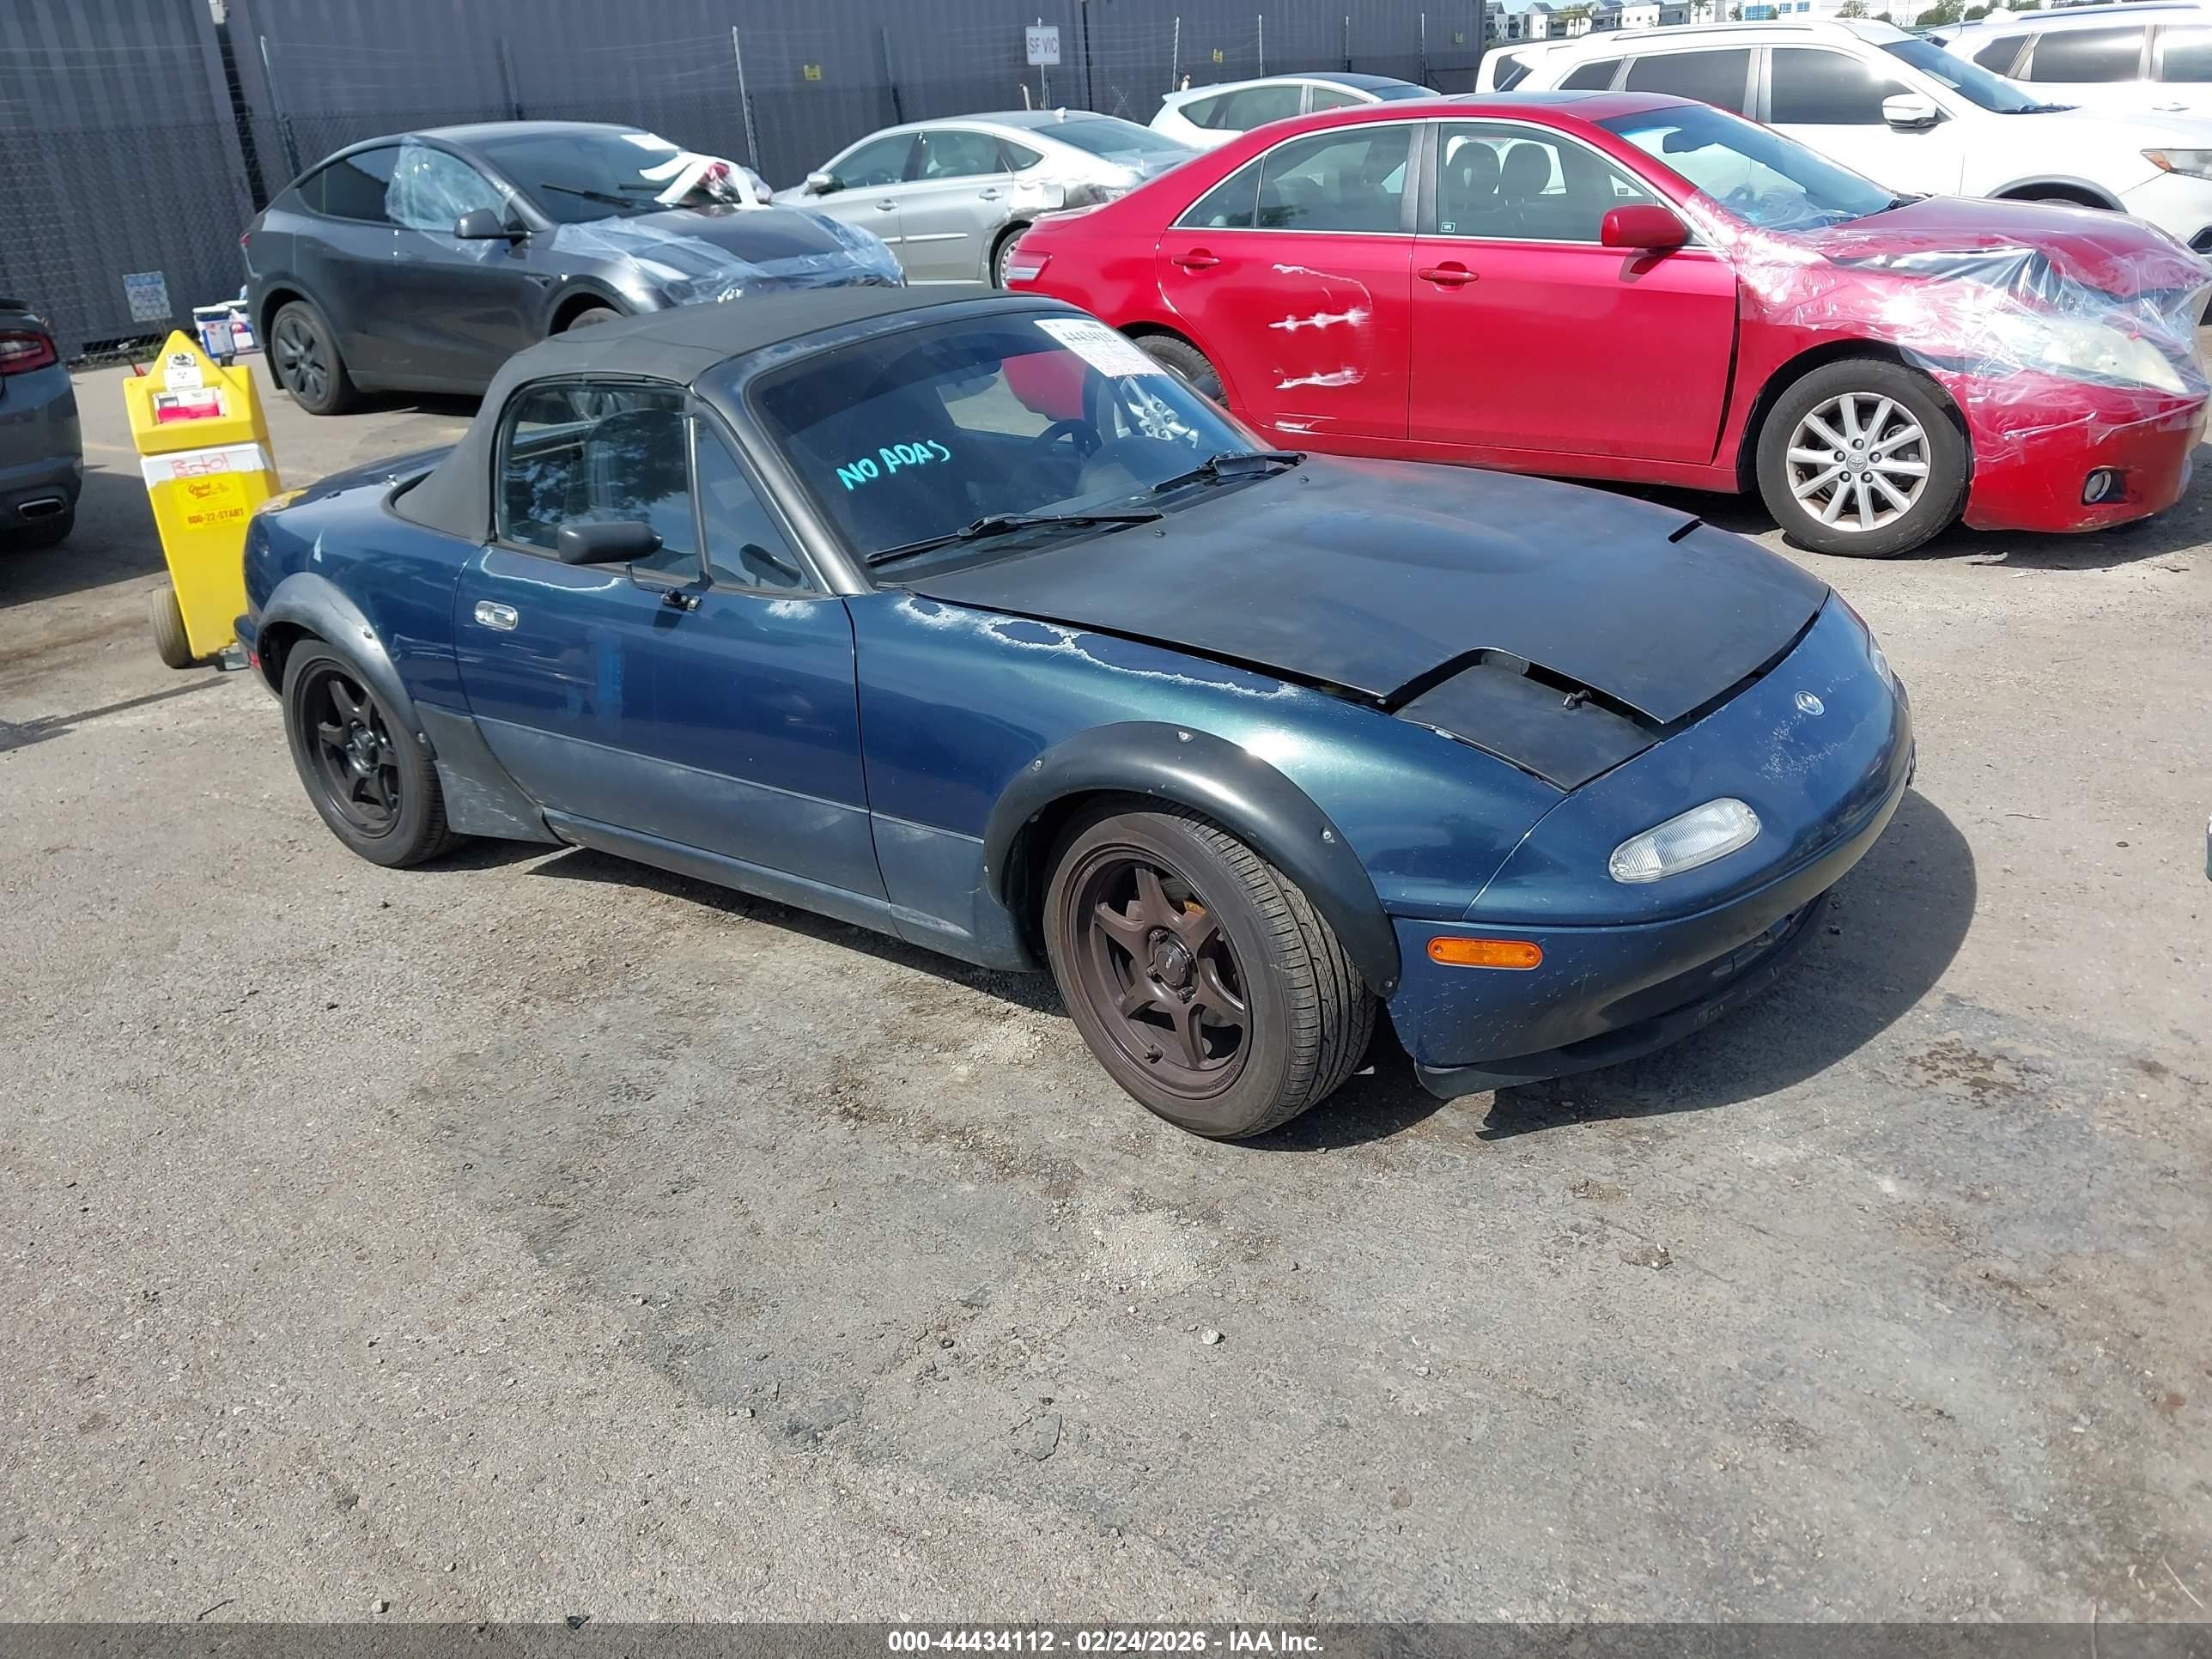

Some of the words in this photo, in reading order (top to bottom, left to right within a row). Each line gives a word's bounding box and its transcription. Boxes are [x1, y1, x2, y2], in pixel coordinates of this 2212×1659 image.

[1029, 38, 1040, 54] SF
[1042, 37, 1058, 54] VIC
[836, 458, 878, 490] NO
[879, 440, 951, 474] ADAS
